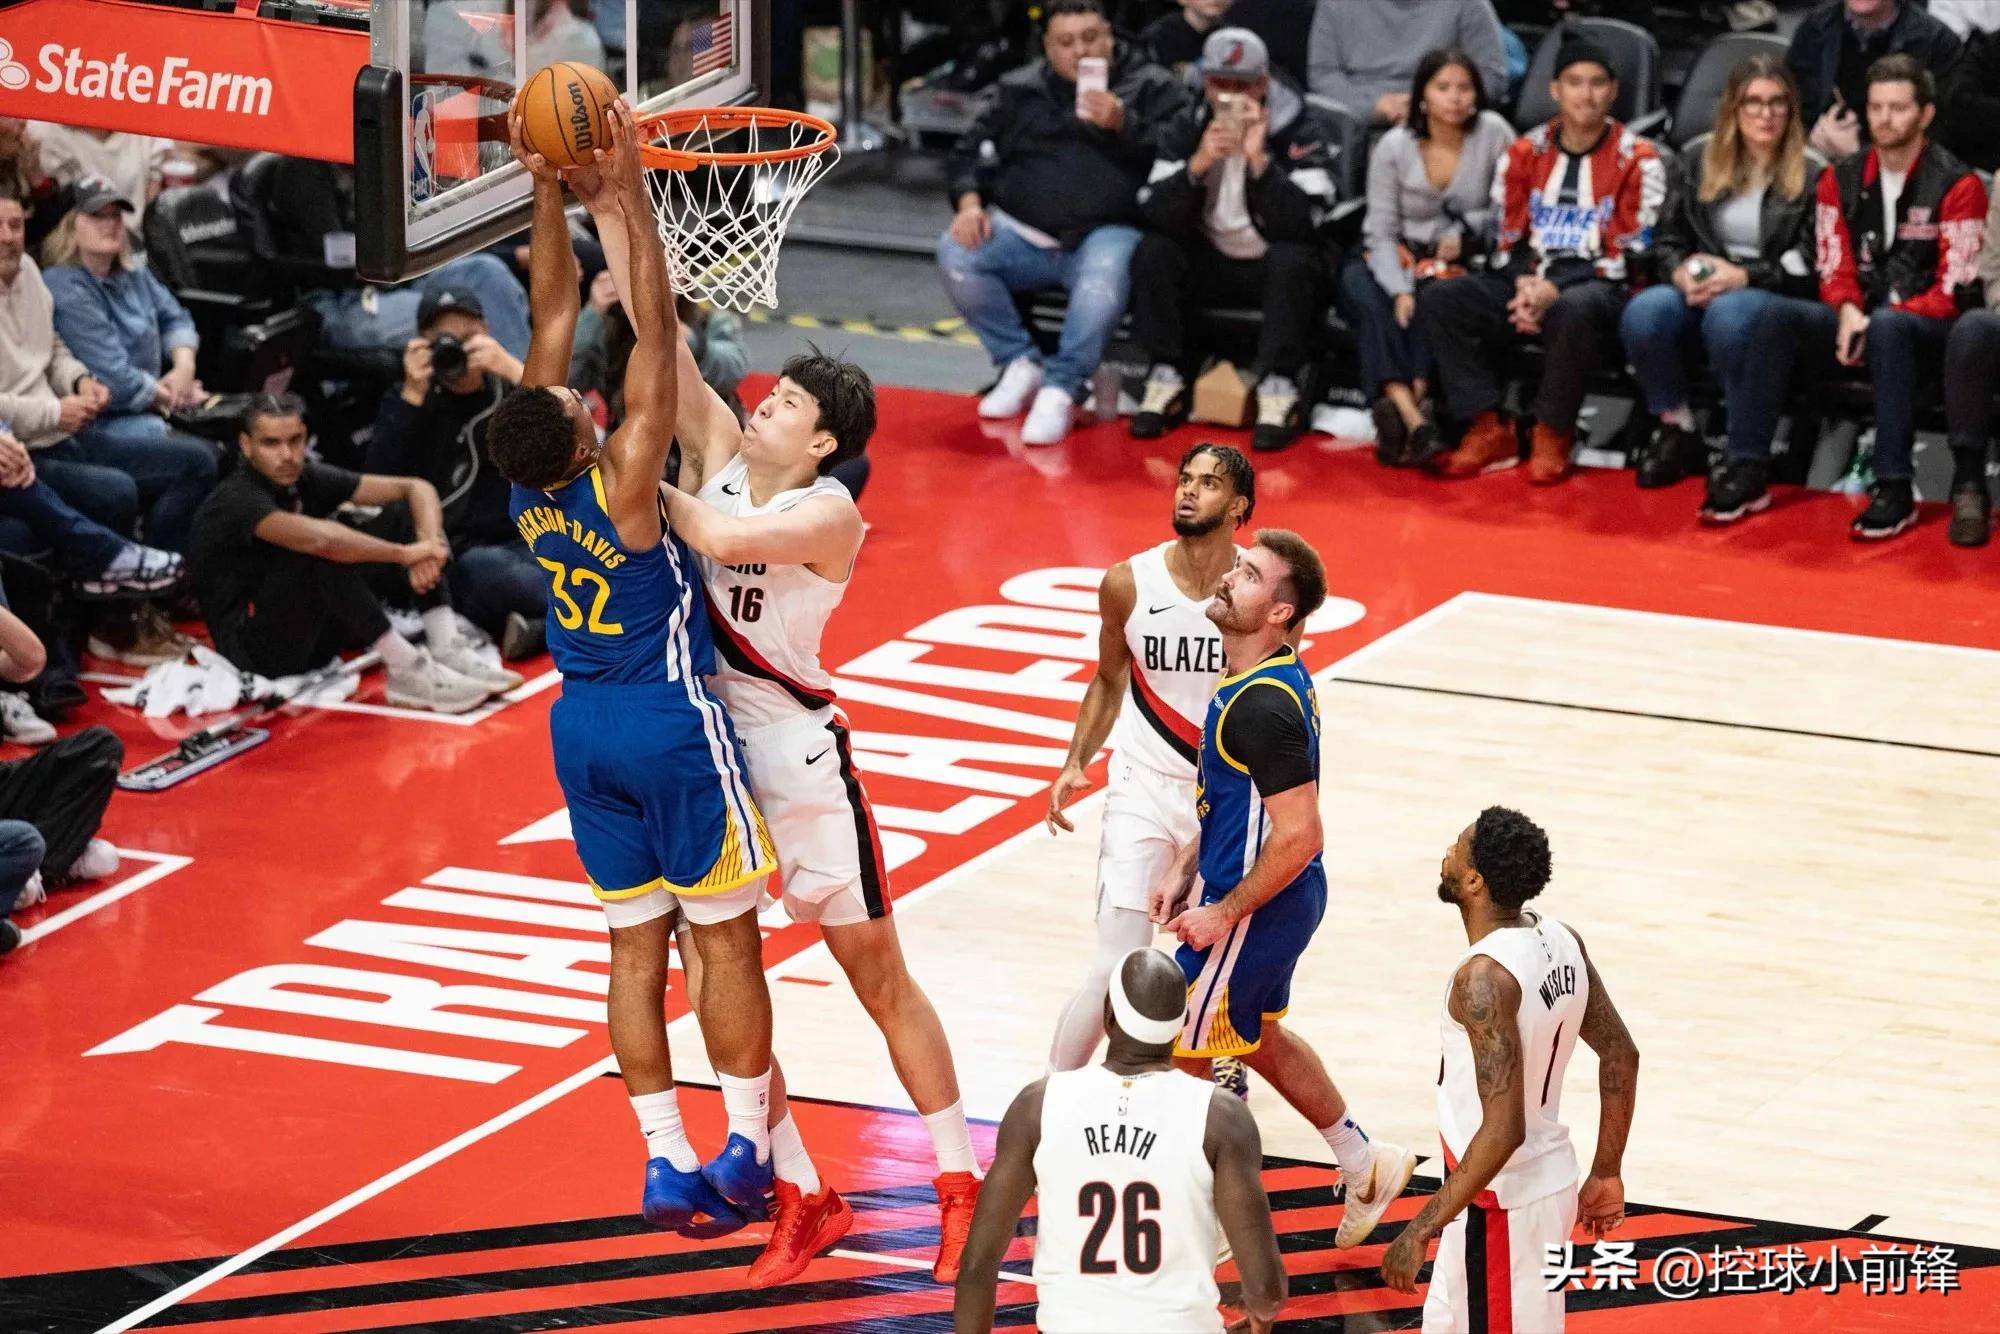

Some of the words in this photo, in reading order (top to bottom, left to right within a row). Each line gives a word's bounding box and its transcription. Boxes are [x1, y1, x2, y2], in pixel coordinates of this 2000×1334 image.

[567, 82, 594, 152] Wilson
[517, 505, 627, 570] ACKSON-DAVIS
[535, 555, 625, 636] 32
[728, 584, 765, 624] 16
[1142, 634, 1227, 674] BLAZE
[1539, 965, 1577, 1013] WESLEY
[1540, 1020, 1565, 1109] 1
[1084, 1124, 1158, 1161] REATH
[1077, 1180, 1163, 1276] 26
